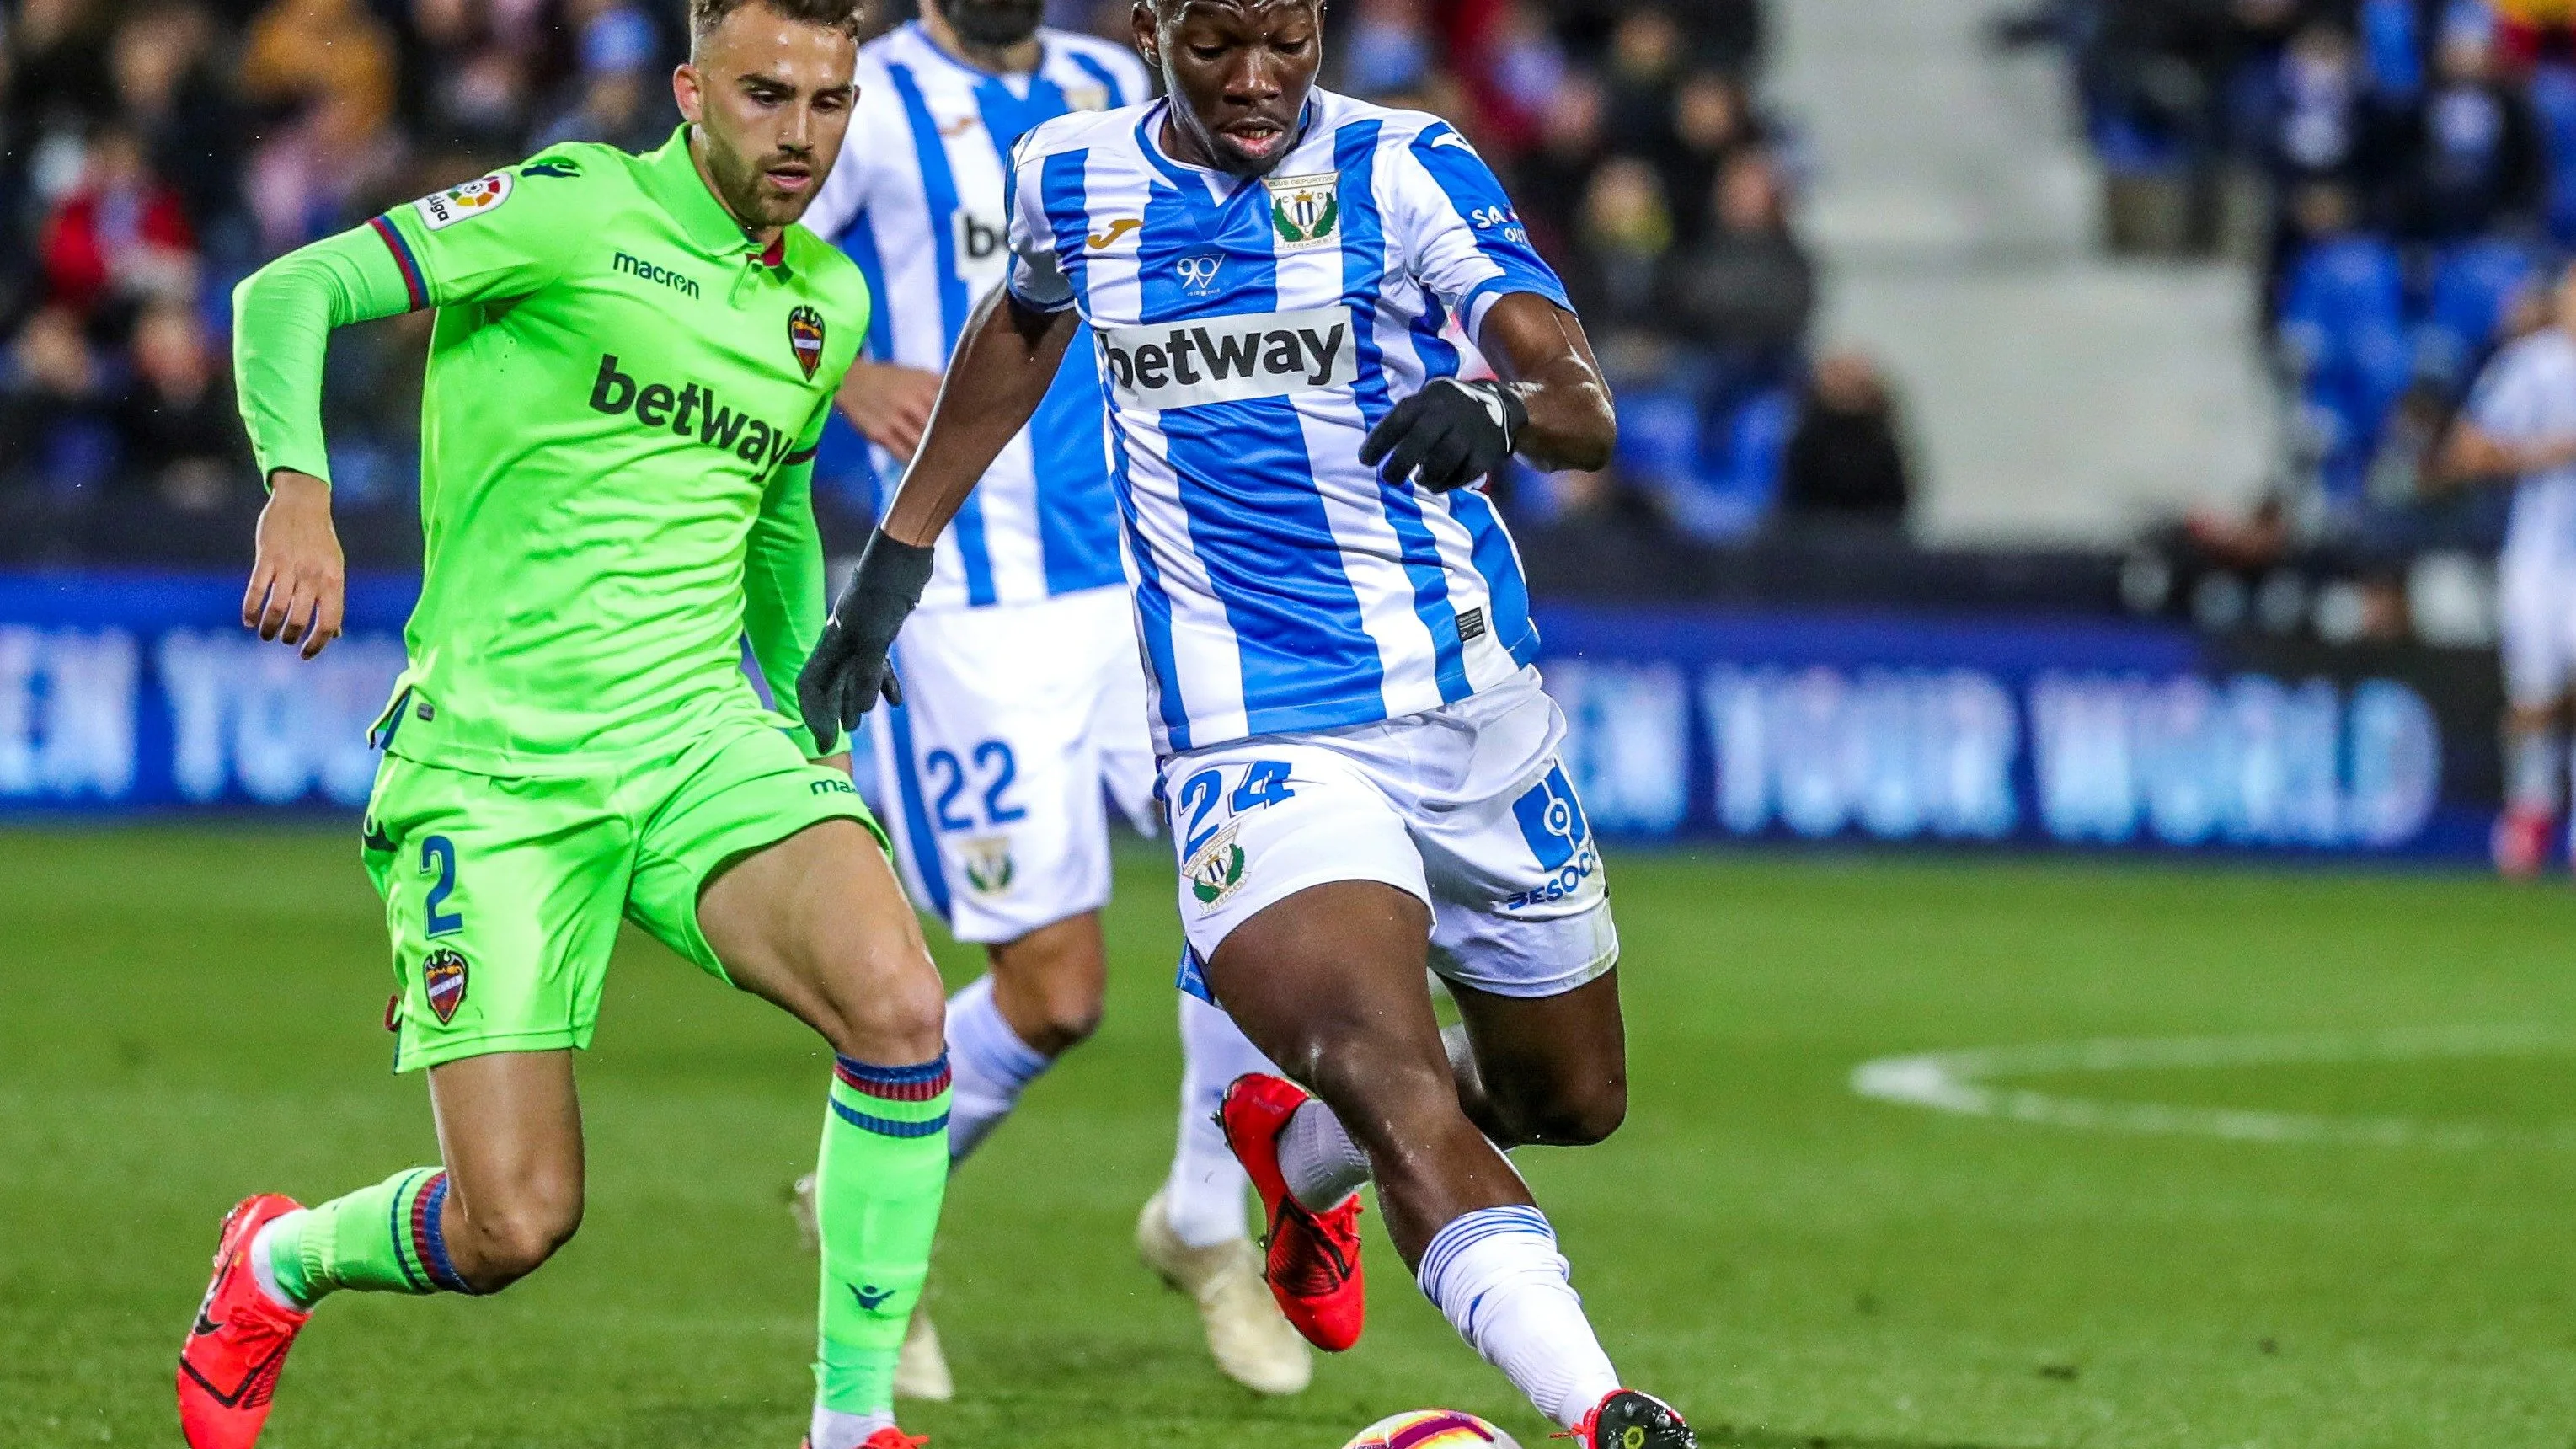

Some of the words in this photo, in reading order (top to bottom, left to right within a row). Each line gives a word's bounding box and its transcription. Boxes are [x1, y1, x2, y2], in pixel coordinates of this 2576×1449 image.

[613, 252, 699, 300] macron
[1100, 323, 1345, 390] betway
[589, 353, 793, 483] betway
[810, 779, 857, 795] ma
[927, 741, 1027, 830] 22
[2032, 670, 2440, 846] WORLD
[1178, 761, 1296, 865] 24
[420, 835, 463, 940] 2
